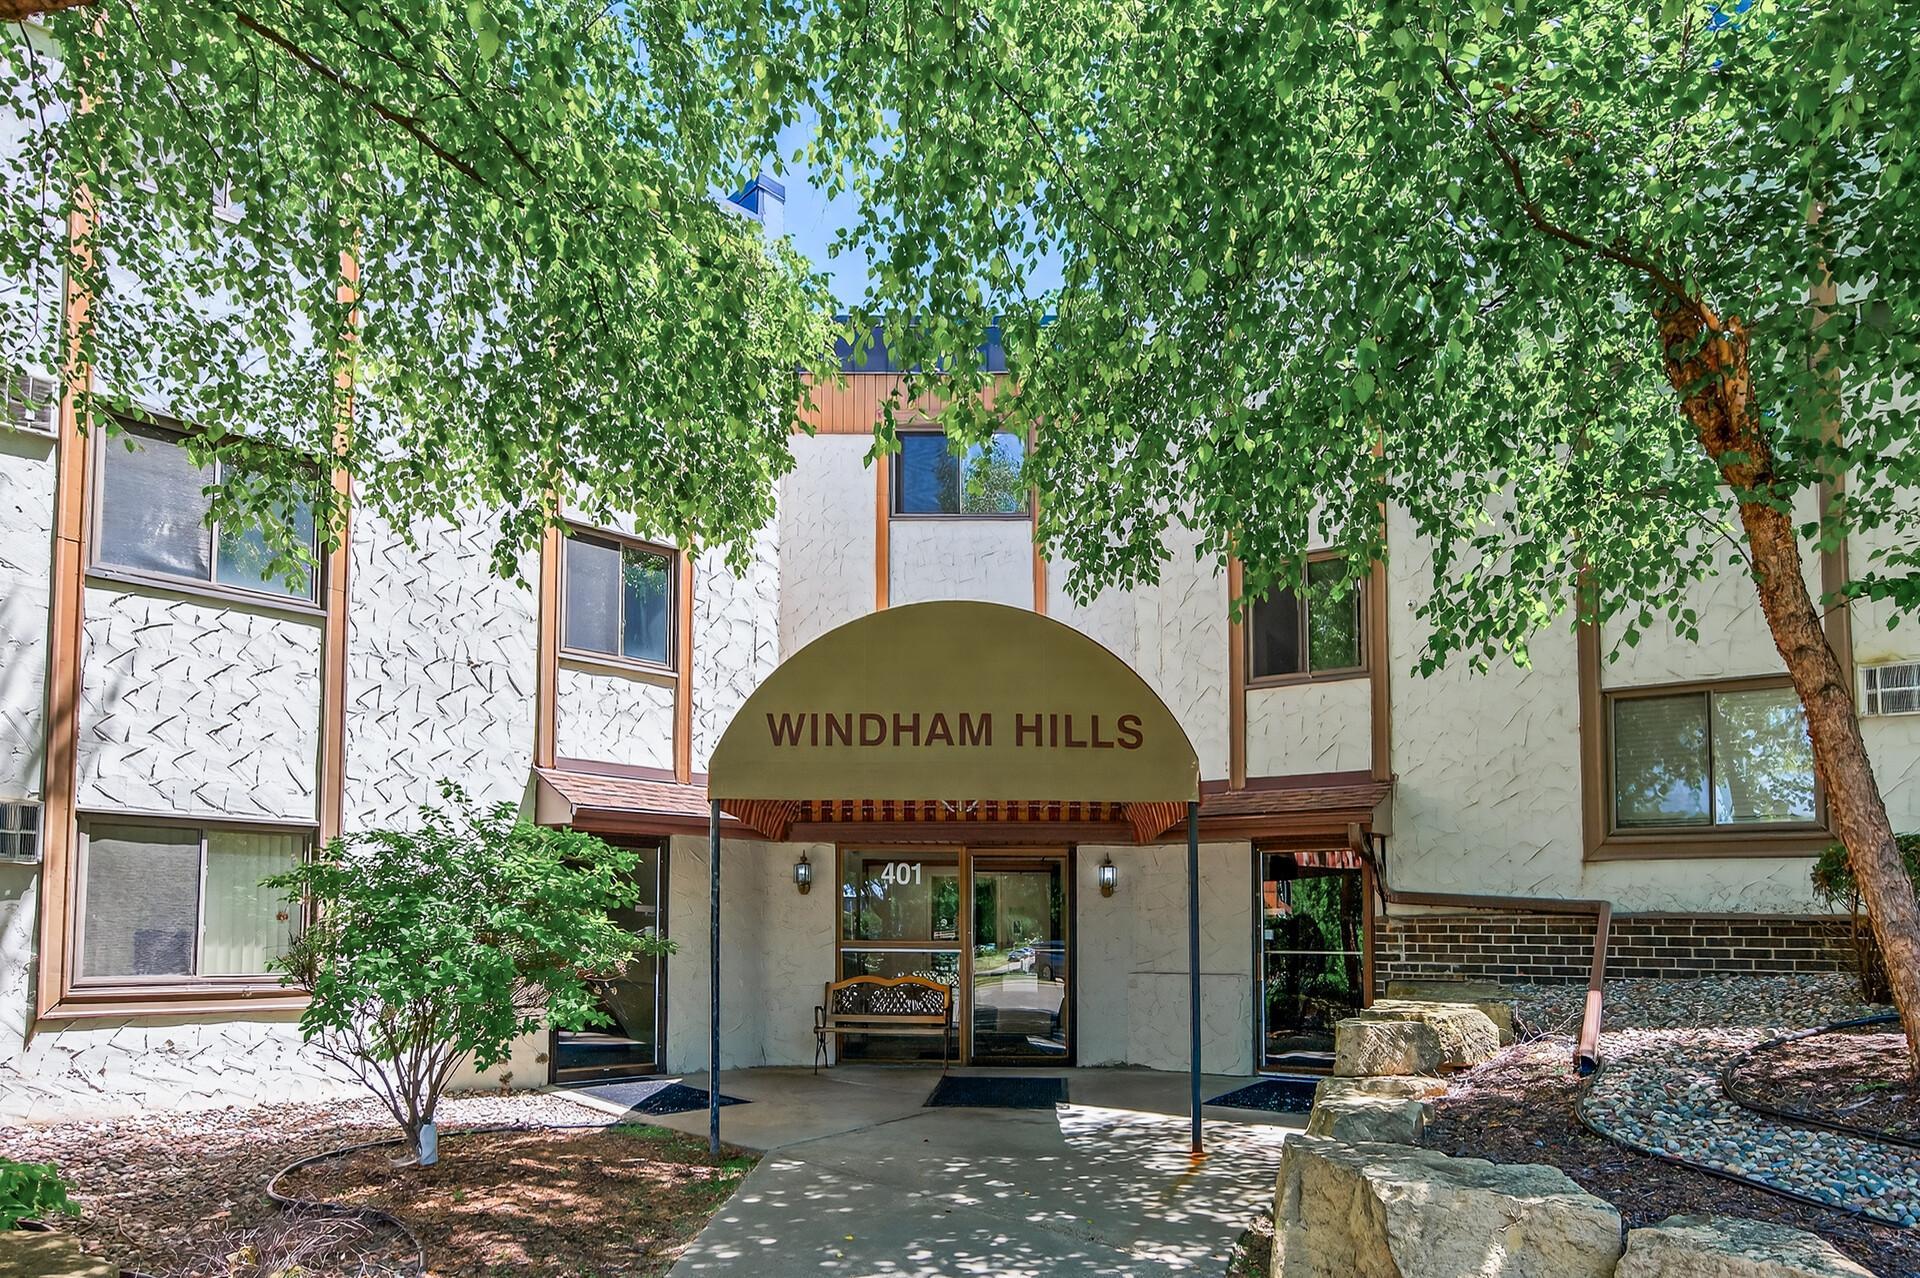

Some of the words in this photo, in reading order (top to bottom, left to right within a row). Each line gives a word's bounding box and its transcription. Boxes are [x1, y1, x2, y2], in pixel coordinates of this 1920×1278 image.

[766, 712, 992, 747] WINDHAM
[1015, 712, 1144, 749] HILLS
[881, 862, 921, 885] 401
